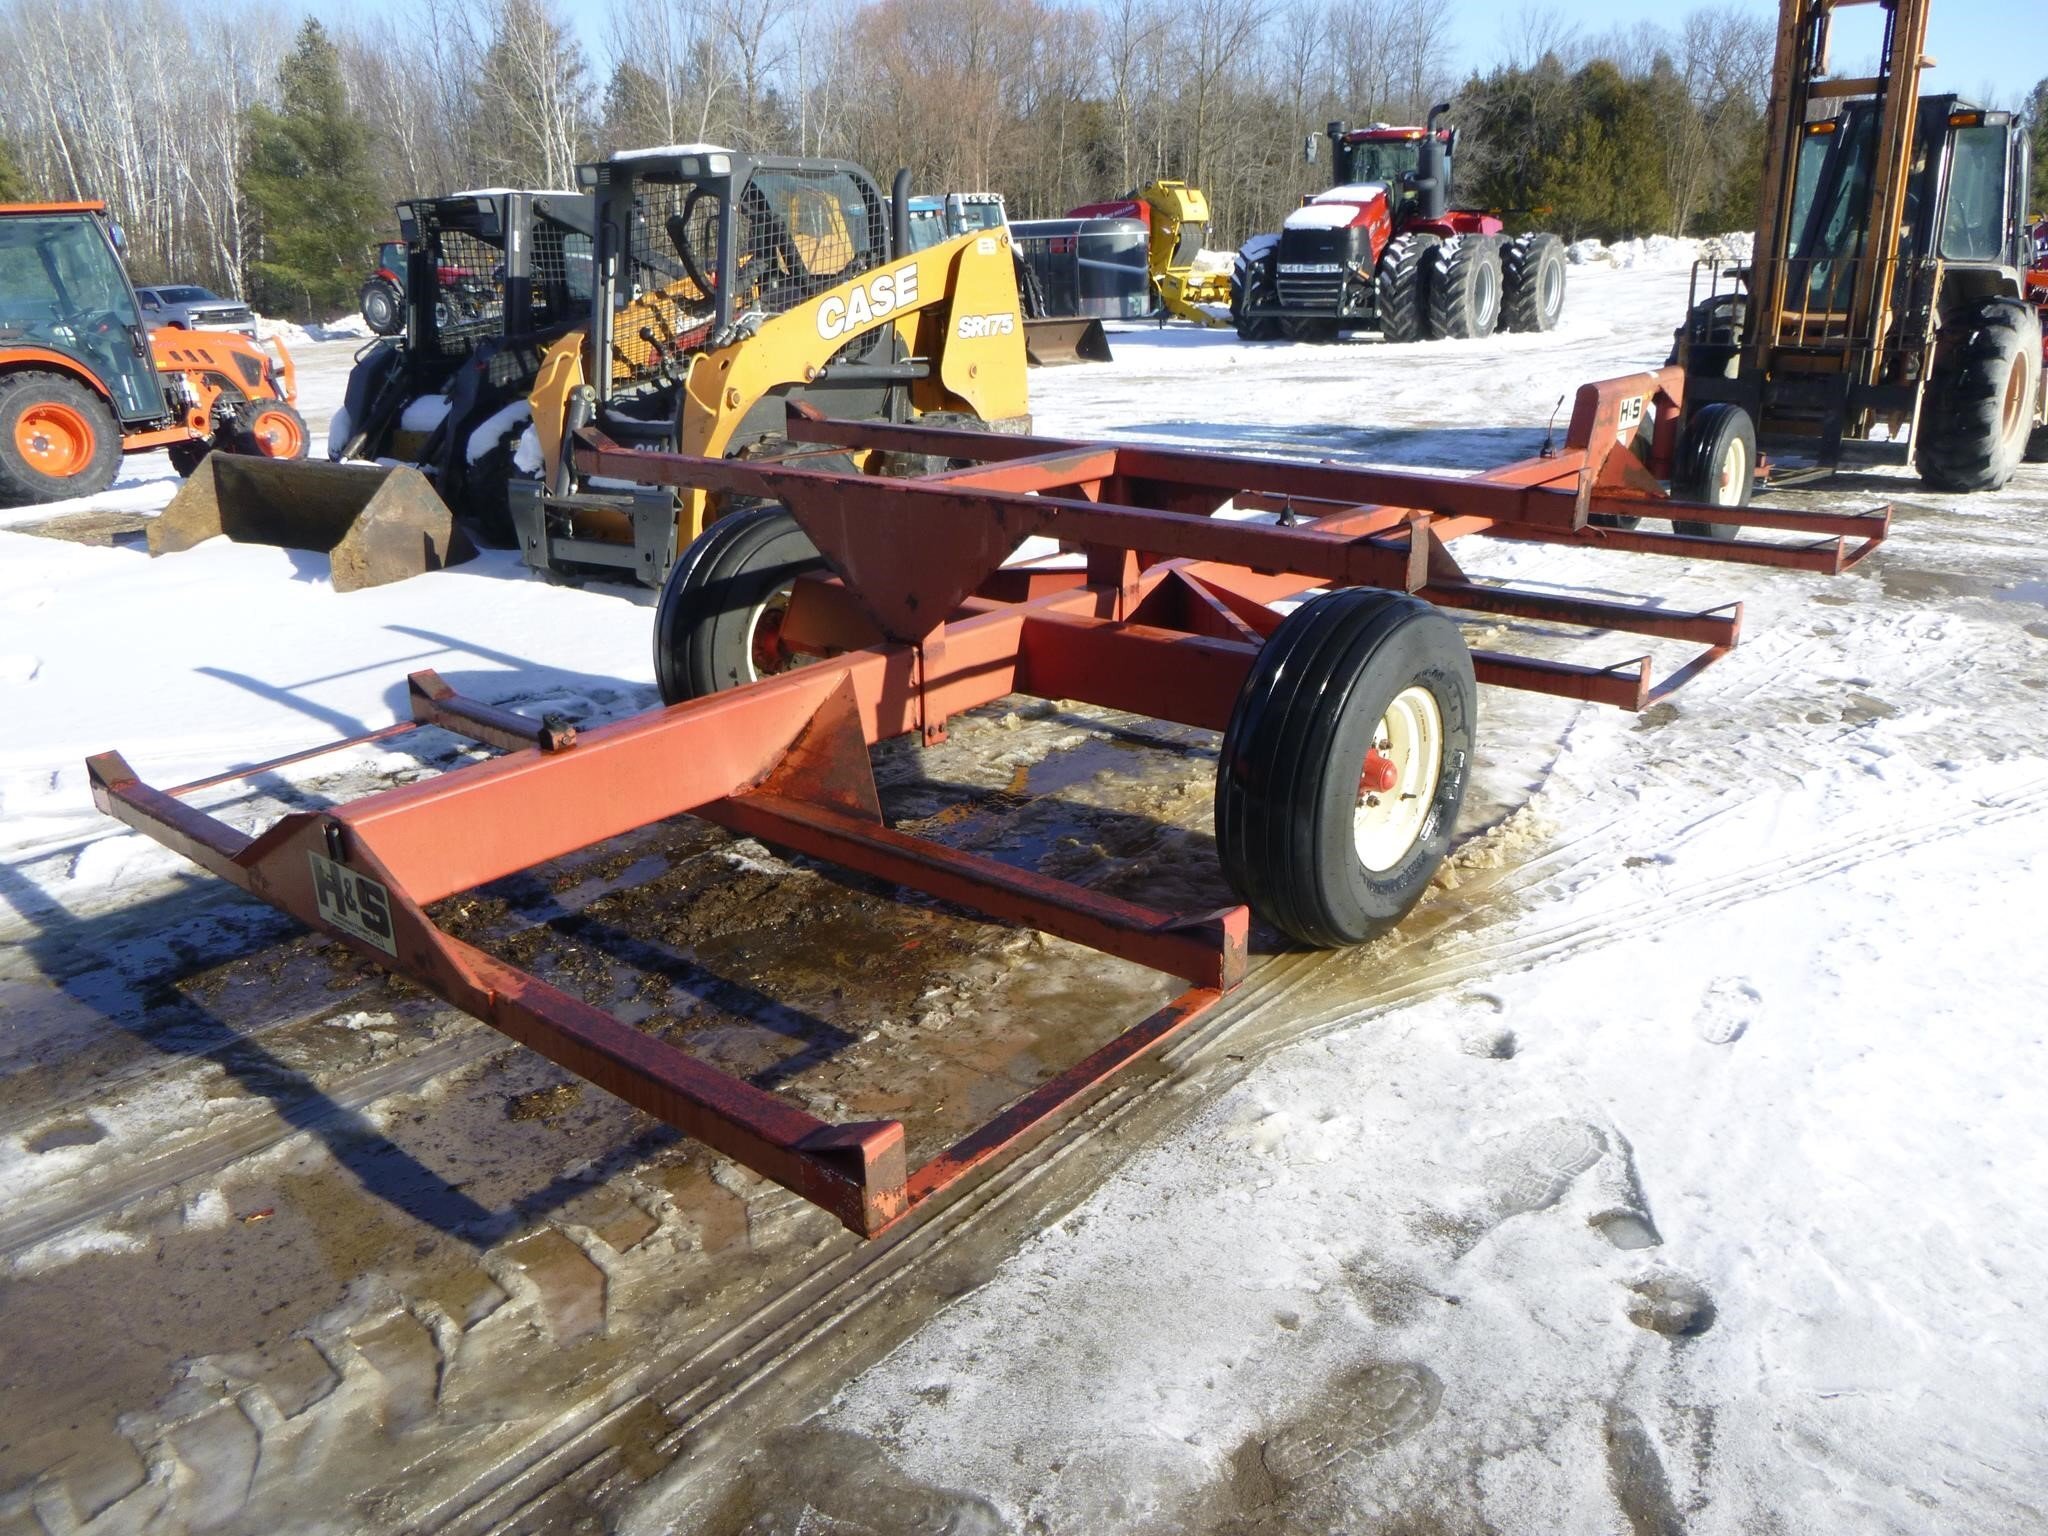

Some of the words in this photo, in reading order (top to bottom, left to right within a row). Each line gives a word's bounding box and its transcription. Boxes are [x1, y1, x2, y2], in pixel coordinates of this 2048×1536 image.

[816, 262, 919, 340] CASE
[957, 313, 1015, 339] SR175
[310, 855, 391, 939] H&S
